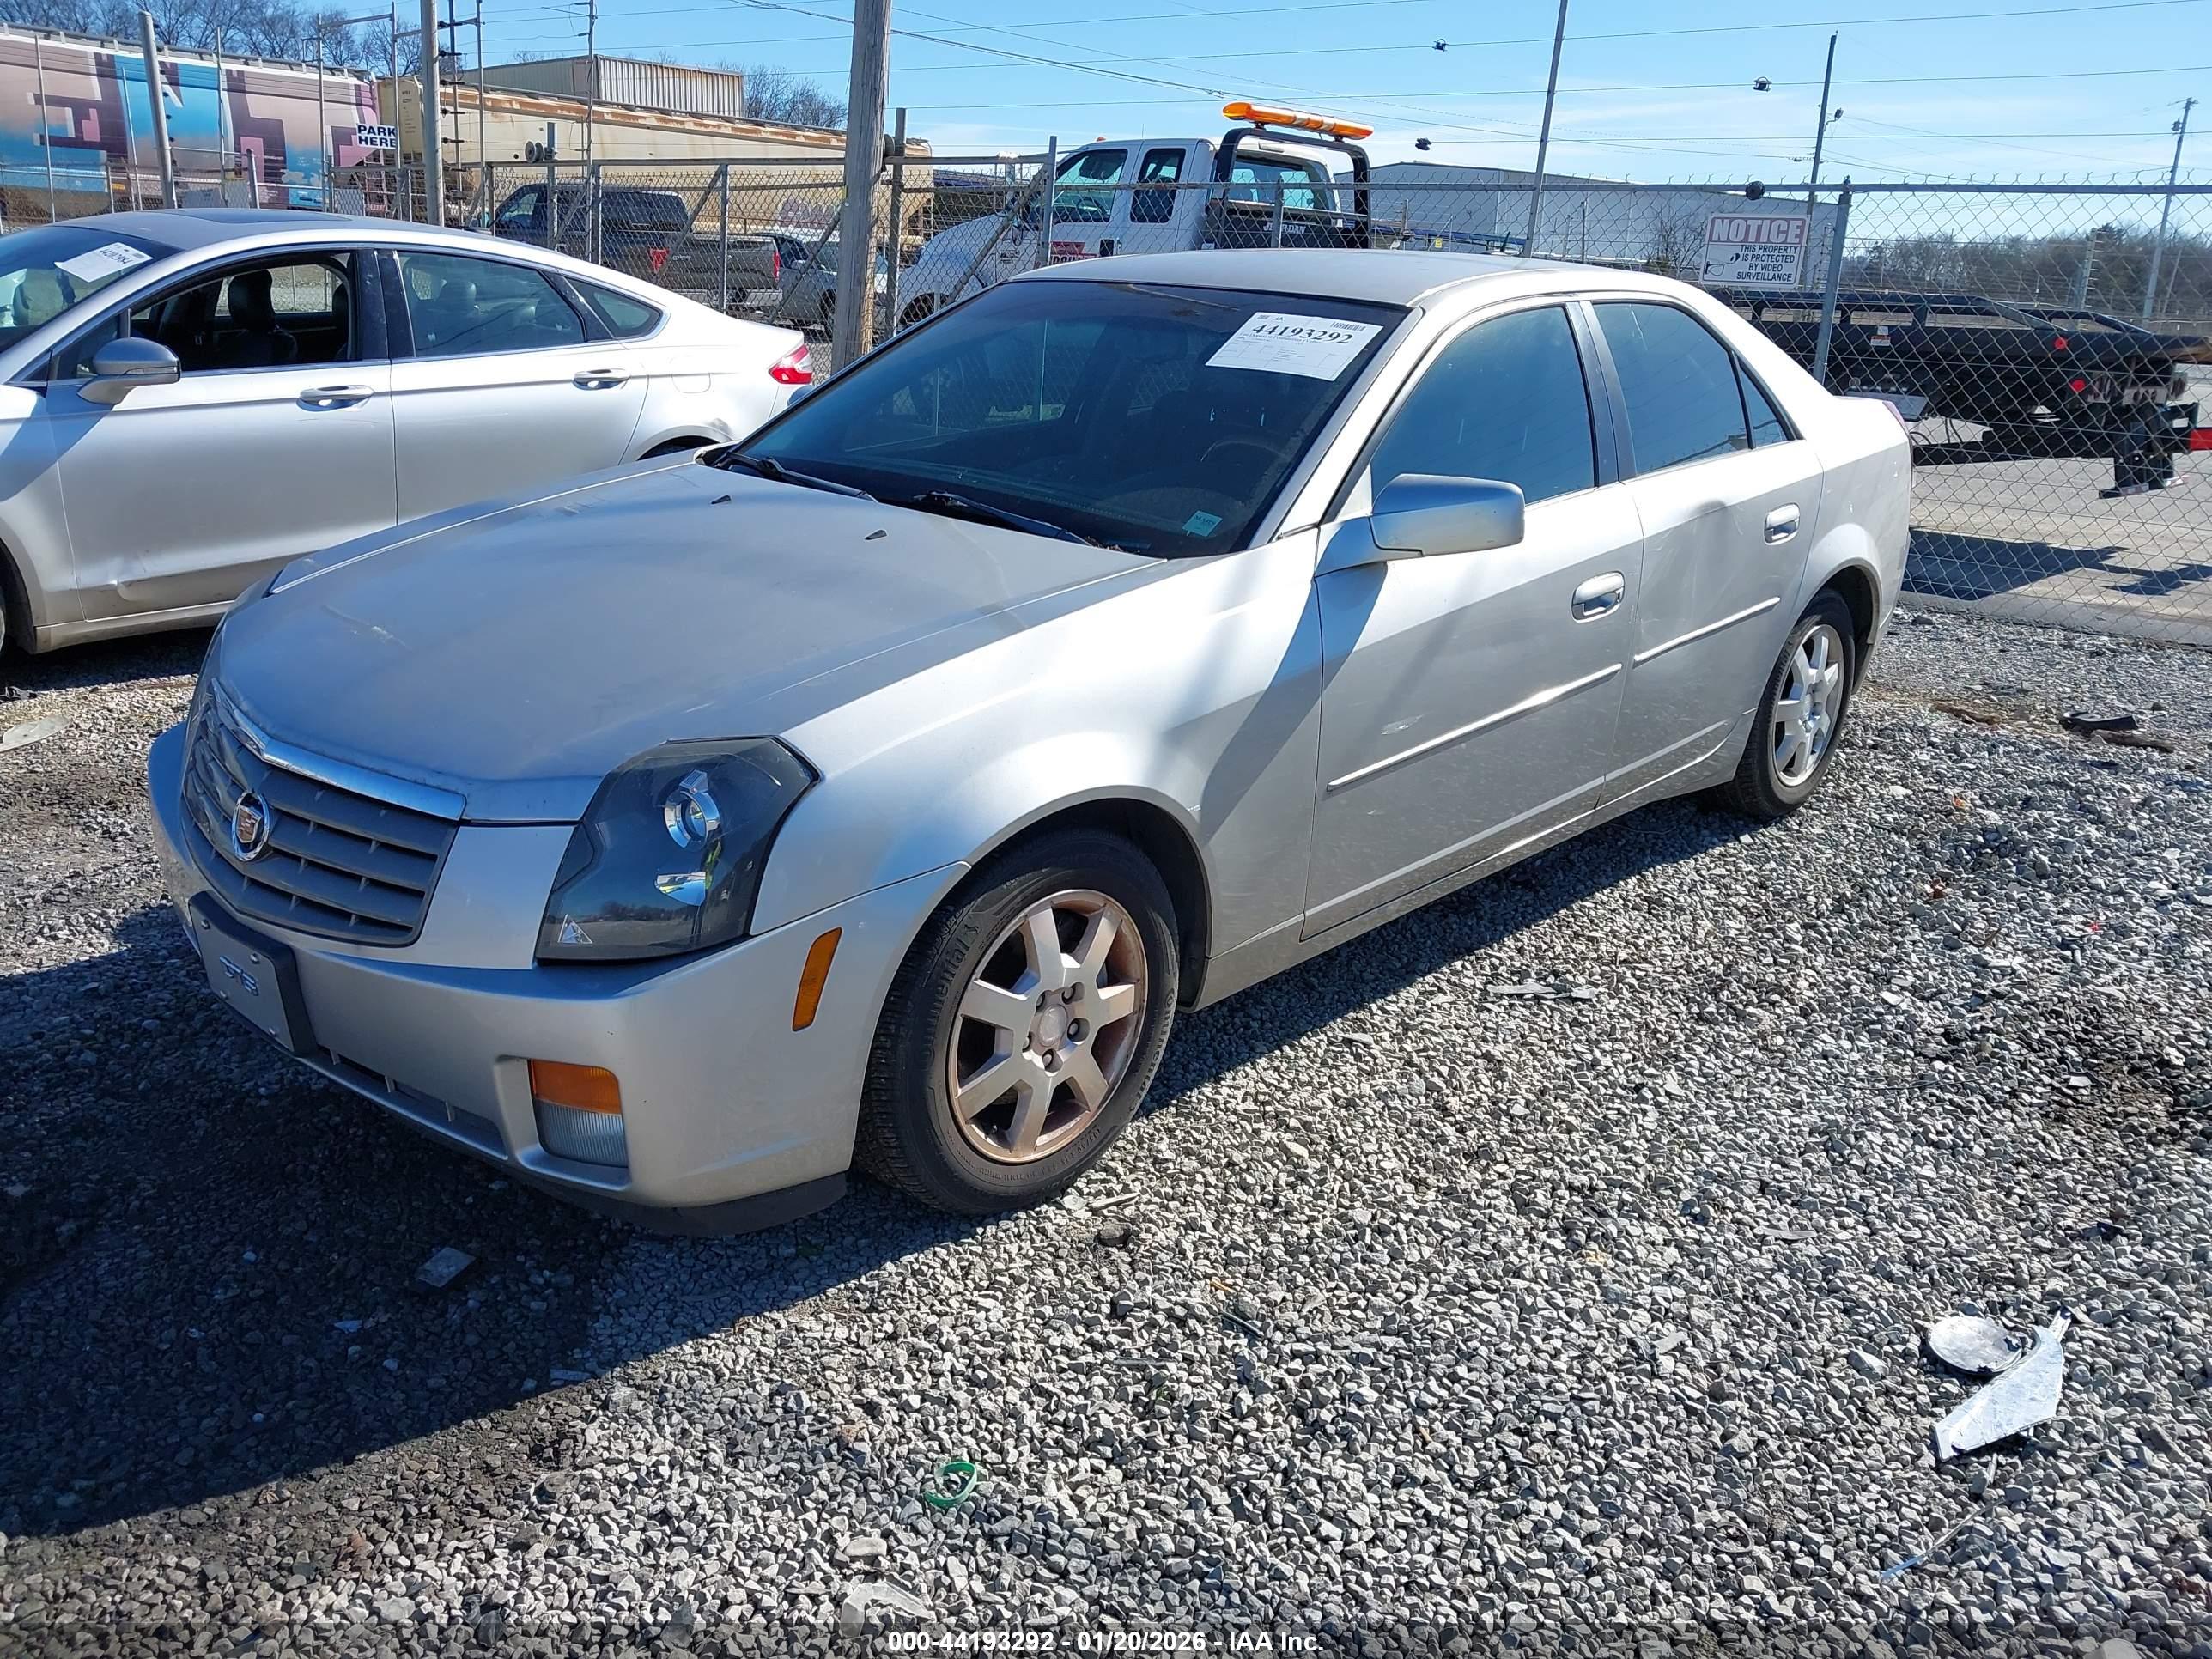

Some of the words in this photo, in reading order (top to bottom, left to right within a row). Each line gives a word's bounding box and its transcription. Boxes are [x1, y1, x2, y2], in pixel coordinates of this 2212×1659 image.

[357, 125, 397, 137] PARK
[358, 136, 397, 148] HERE
[1711, 218, 1802, 243] NOTICE
[1759, 245, 1798, 254] PROPERTY
[1741, 253, 1748, 262] IS
[1751, 254, 1795, 263] PROTECTED
[1748, 263, 1759, 271] BY
[1760, 263, 1783, 272] VIDEO
[1736, 271, 1793, 282] SURVEILLANCE
[1252, 324, 1353, 344] 44193292
